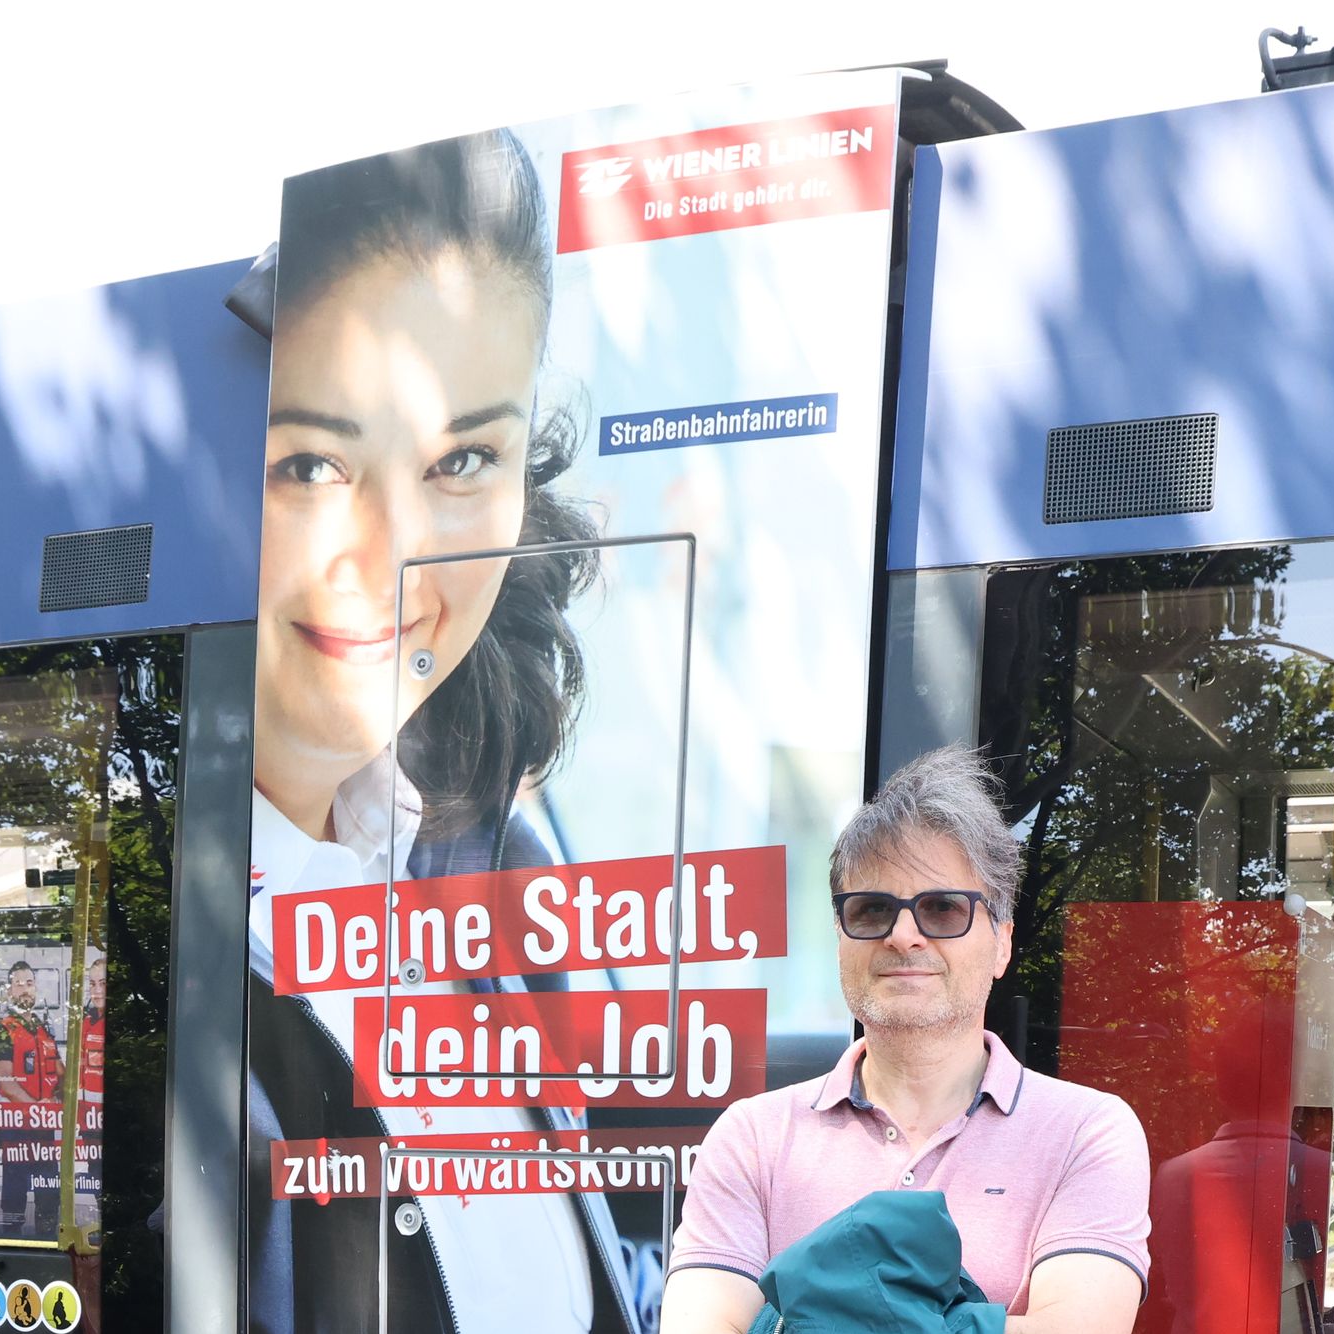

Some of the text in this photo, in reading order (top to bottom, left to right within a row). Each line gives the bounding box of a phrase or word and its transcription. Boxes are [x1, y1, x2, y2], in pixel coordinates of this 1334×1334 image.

[643, 127, 873, 182] WIENER LINIEN
[644, 199, 672, 221] Die
[679, 190, 727, 215] Stadt
[733, 179, 795, 212] gehört
[610, 401, 827, 446] Straßenbahnfahrerin
[294, 863, 759, 984] Deine Stadt,
[377, 1000, 733, 1099] dein Job
[7, 1142, 29, 1161] mit
[283, 1154, 366, 1194] zum
